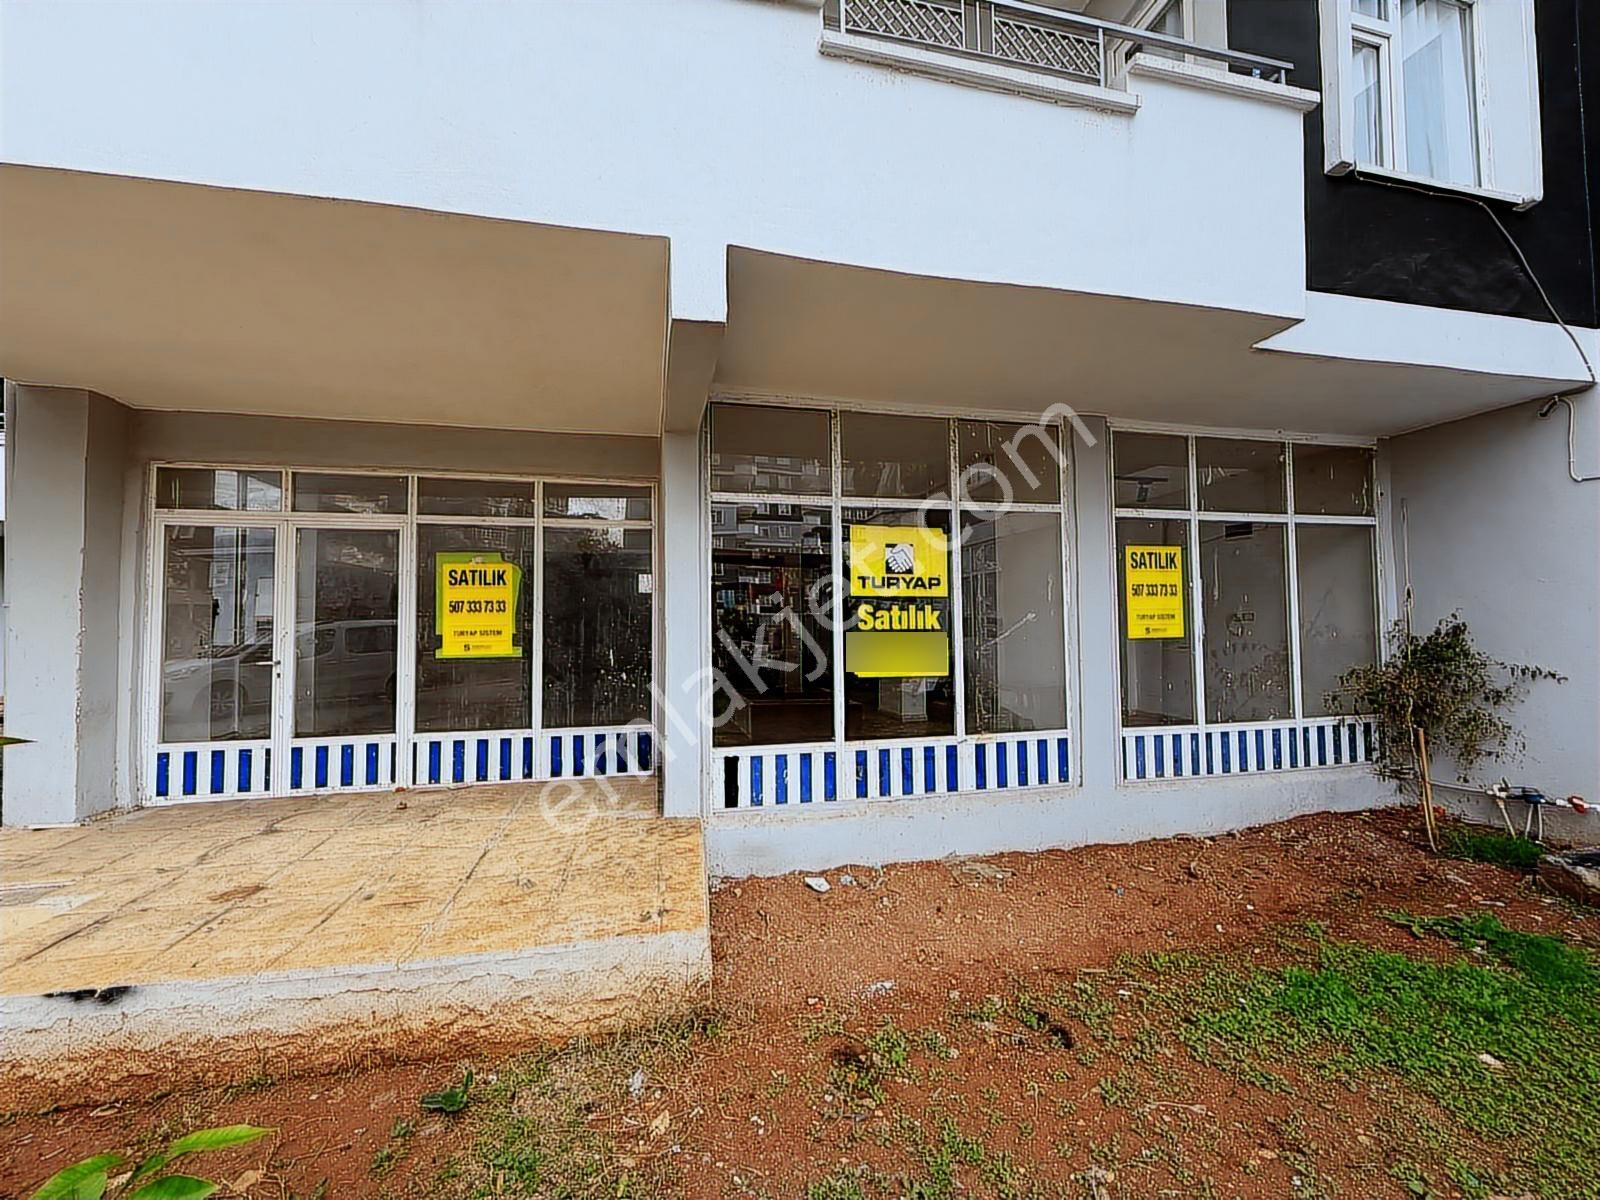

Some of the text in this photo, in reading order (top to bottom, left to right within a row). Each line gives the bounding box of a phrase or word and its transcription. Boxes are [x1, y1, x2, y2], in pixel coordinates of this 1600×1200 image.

[1130, 551, 1178, 570] SATILIK
[448, 569, 507, 586] SATILIK
[857, 576, 942, 590] TURYAP
[449, 600, 465, 614] 507
[466, 600, 482, 613] 333
[496, 600, 507, 613] 33
[857, 603, 942, 631] Satılık
